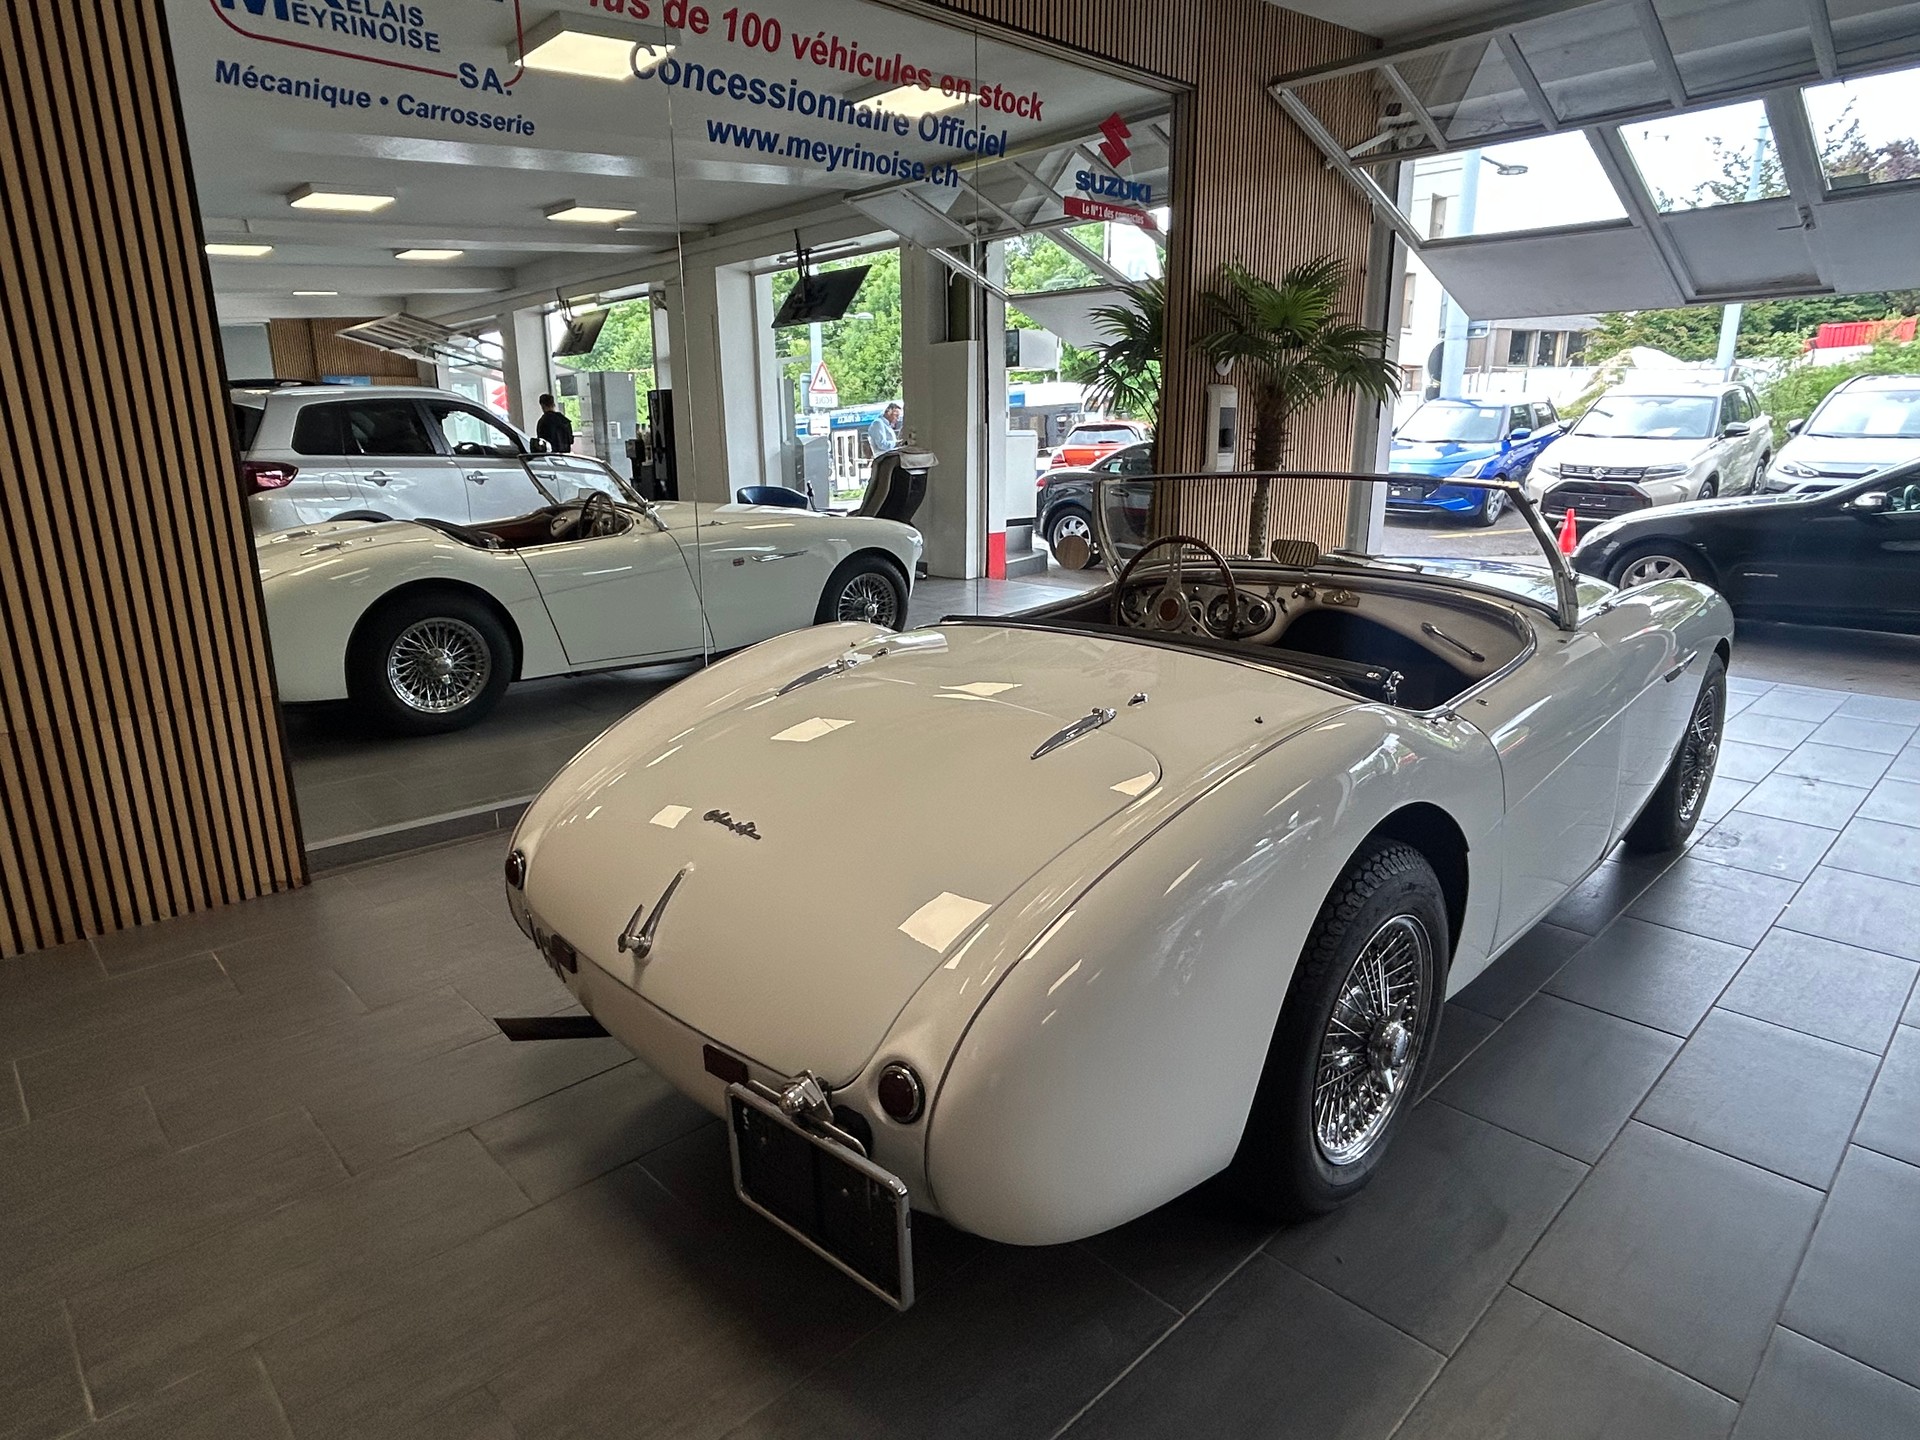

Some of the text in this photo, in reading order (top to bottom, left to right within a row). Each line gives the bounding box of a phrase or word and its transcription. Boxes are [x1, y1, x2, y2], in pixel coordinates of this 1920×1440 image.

[215, 59, 535, 136] Mécanique Carrosserie
[663, 0, 710, 35] de
[722, 7, 782, 52] 100
[791, 31, 932, 91] véhicules
[940, 74, 971, 104] en
[978, 83, 1044, 122] stock
[629, 41, 1008, 158] Concessionnaire Officiel
[706, 119, 959, 188] www.meyrinoise.ch
[1075, 170, 1151, 203] SUZUKI
[1082, 202, 1090, 215] Le
[1103, 206, 1115, 219] des
[1115, 211, 1144, 225] cactes
